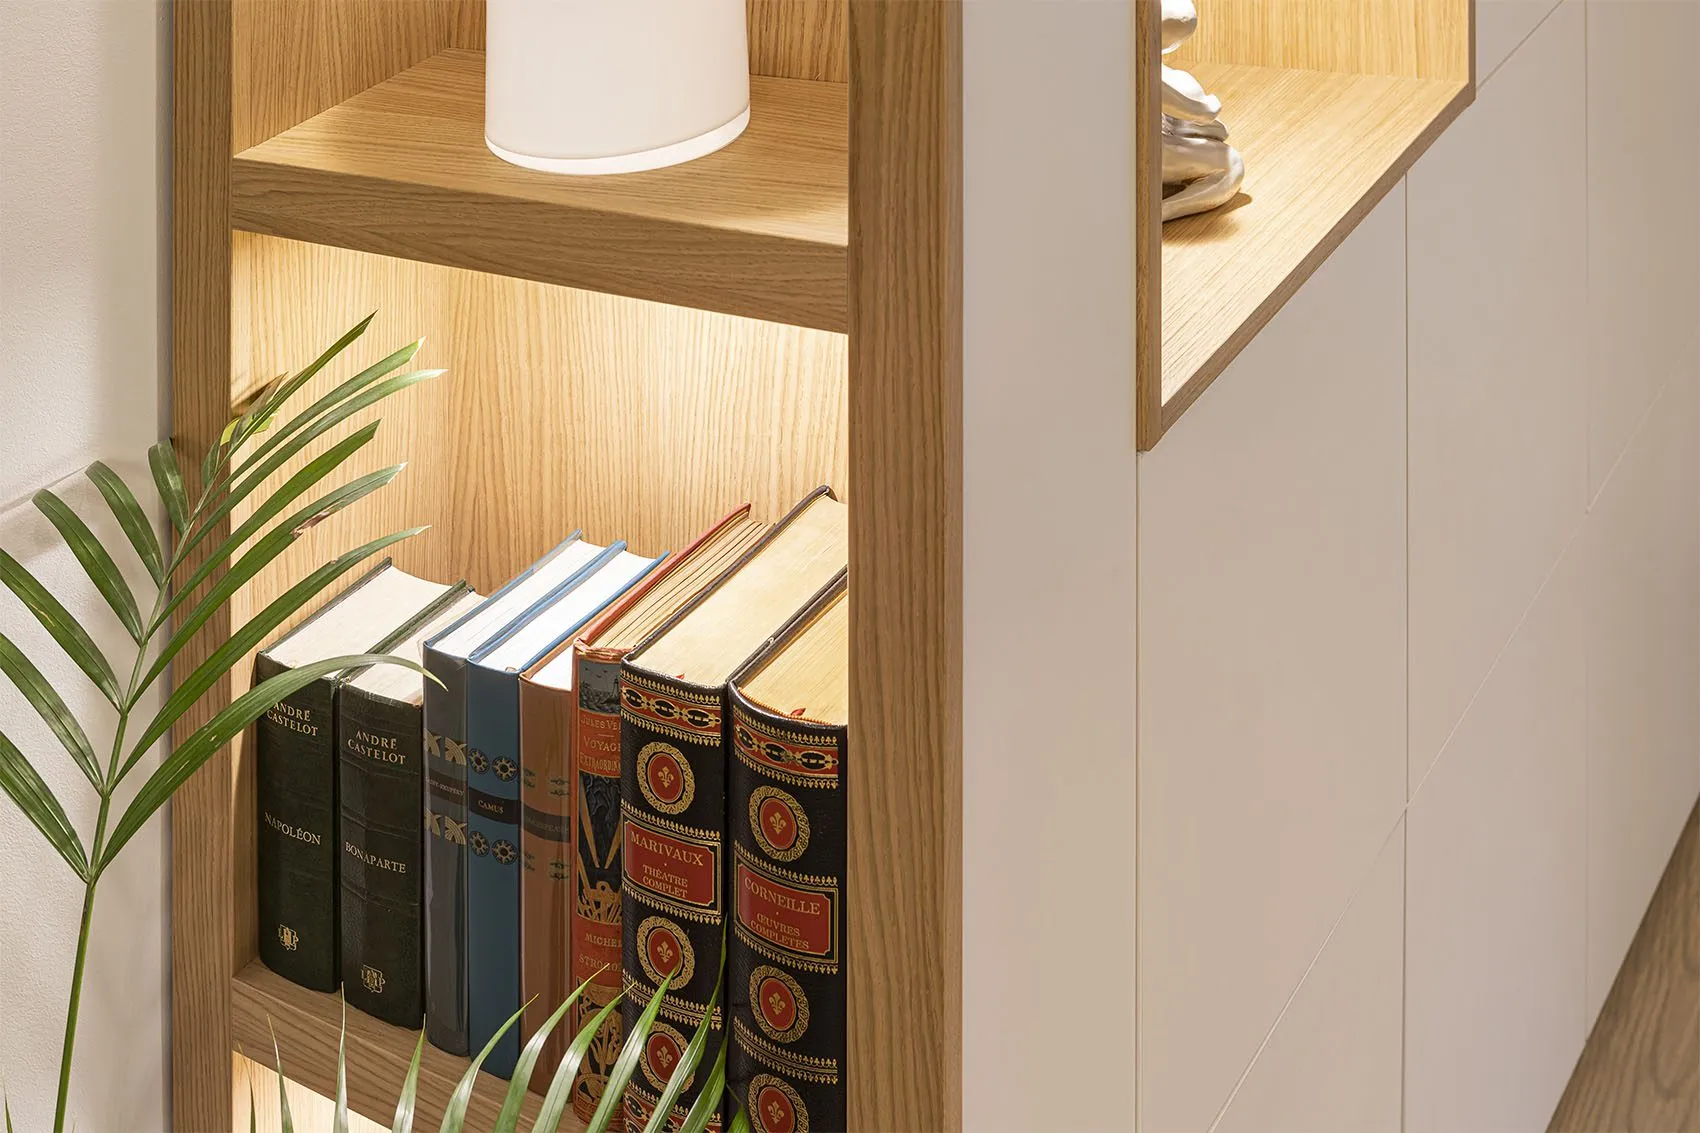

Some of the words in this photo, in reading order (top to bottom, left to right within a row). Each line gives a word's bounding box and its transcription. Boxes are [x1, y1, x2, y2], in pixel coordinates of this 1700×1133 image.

[267, 710, 318, 736] CASTELOT
[580, 715, 606, 729] JULES
[607, 719, 621, 731] VE
[347, 738, 406, 765] CASTELOT
[583, 735, 621, 752] VOYAG
[580, 751, 621, 773] EXTRAORDIN
[478, 799, 504, 815] CAMUS
[264, 811, 321, 845] NAPOLÉON
[345, 841, 406, 874] BONAPARTE
[631, 831, 704, 866] MARIVAUX
[642, 875, 688, 898] COMPLET
[744, 876, 820, 916] CORNEILLE
[757, 912, 800, 937] ŒUVRES
